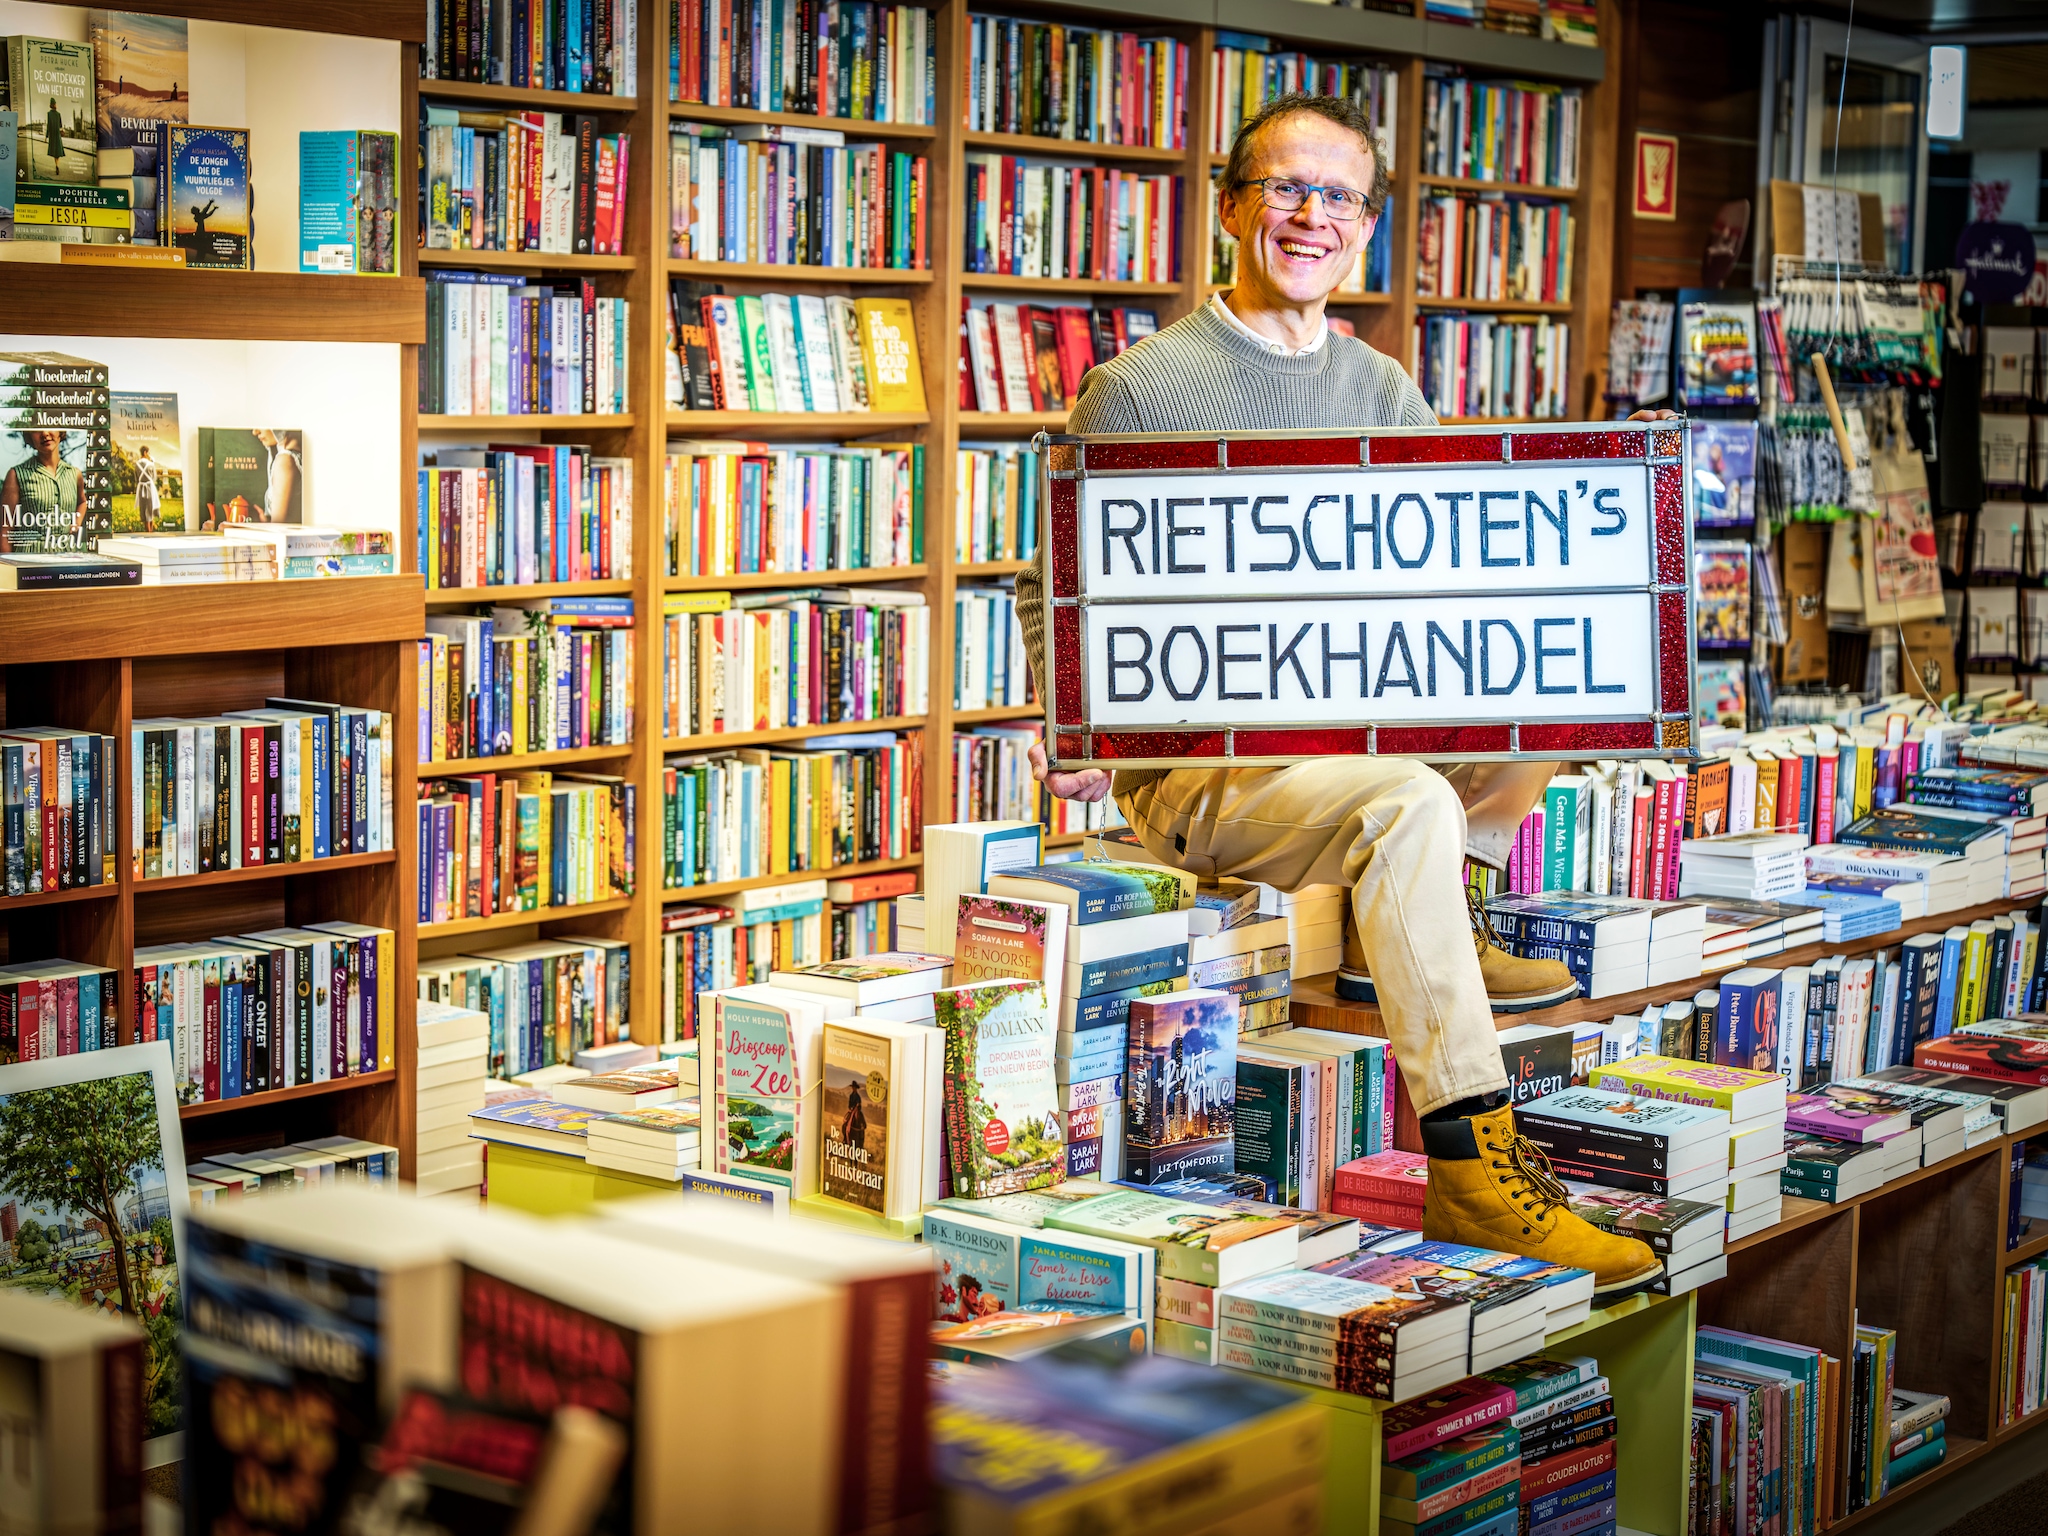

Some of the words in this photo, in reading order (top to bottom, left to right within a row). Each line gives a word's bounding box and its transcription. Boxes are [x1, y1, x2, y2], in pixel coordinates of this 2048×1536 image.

[34, 70, 43, 80] DE
[45, 71, 86, 86] ONTDEKKER
[36, 83, 50, 94] VAN
[52, 84, 62, 96] HET
[64, 86, 84, 98] LEVEN
[190, 156, 200, 164] DE
[201, 157, 228, 166] JONGEN
[198, 166, 209, 175] DIE
[212, 167, 220, 176] DE
[184, 176, 234, 186] VUURVLIEGJES
[60, 188, 98, 197] DOCHTER
[196, 186, 223, 196] VOLGDE
[50, 208, 87, 224] JESCA
[544, 186, 557, 233] Nexus
[560, 198, 571, 236] Nexus
[1965, 251, 2028, 276] Hallmark
[869, 311, 883, 325] JE
[871, 325, 900, 341] KIND
[874, 339, 886, 355] IS
[888, 340, 909, 355] EEN
[875, 355, 908, 370] GOUD
[34, 368, 92, 383] Moederheil
[877, 369, 907, 384] MIJN
[36, 390, 93, 405] Moederheil
[37, 412, 94, 427] Moederheil
[120, 408, 132, 418] De
[136, 409, 163, 420] kraam
[126, 420, 157, 431] kliniek
[2, 504, 81, 528] Moeder
[1101, 479, 1627, 576] RIETSCHOTEN's
[44, 526, 83, 549] heil
[1106, 616, 1626, 702] BOEKHANDEL
[250, 738, 259, 784] ONTWAKEN
[269, 740, 278, 779] OPSTAND
[1701, 768, 1729, 788] ROOKGAT
[28, 773, 38, 836] Vlindermeisje
[1685, 774, 1697, 823] ROOKGAT
[1556, 795, 1567, 827] Geert
[1556, 829, 1567, 853] Mak
[1846, 865, 1900, 878] ORGANISCH
[1086, 899, 1105, 907] SARAH
[1110, 904, 1120, 912] EEN
[1121, 902, 1133, 911] VER
[1134, 899, 1156, 909] EILAND
[1124, 893, 1137, 902] ROEP
[1138, 892, 1152, 900] VAN
[1537, 920, 1562, 941] LETTER
[1565, 924, 1572, 942] M
[972, 933, 1001, 945] SORAYA
[1004, 939, 1024, 948] LANE
[964, 945, 978, 959] DE
[981, 949, 1032, 969] NOORSE
[1211, 962, 1228, 971] KAREN
[1229, 959, 1248, 968] SWAN
[1089, 971, 1106, 980] SARAH
[1090, 978, 1103, 986] LARK
[1211, 968, 1253, 982] STORMGLOED
[1245, 987, 1278, 1000] VERLANGEN
[1084, 1006, 1102, 1014] SARAH
[1786, 991, 1795, 1020] Virginia
[256, 1000, 267, 1048] ONTZET
[727, 1013, 750, 1023] HOLLY
[752, 1017, 784, 1028] HEPBURN
[994, 1010, 1028, 1020] Corina
[980, 1017, 1045, 1040] BOMANN
[1700, 1013, 1712, 1050] laatste
[1785, 1022, 1793, 1052] Mendoza
[727, 1030, 787, 1063] Bioscoop
[828, 1047, 862, 1062] NICHOLAS
[864, 1056, 886, 1067] EVANS
[989, 1051, 1024, 1064] DROMEN
[1026, 1048, 1042, 1058] VAN
[983, 1066, 998, 1077] EEN
[1000, 1063, 1025, 1075] NIEUW
[1027, 1060, 1050, 1072] BEGIN
[1518, 1056, 1534, 1085] Je
[1924, 1058, 1938, 1067] ROB
[1939, 1060, 1951, 1069] VAN
[1952, 1061, 1970, 1071] ESSEN
[1972, 1066, 1992, 1075] KWADE
[1994, 1068, 2013, 1078] DAGEN
[732, 1068, 751, 1078] aan
[751, 1064, 792, 1096] Zee
[1509, 1074, 1563, 1102] leven
[945, 1080, 954, 1101] EEN
[1074, 1081, 1102, 1098] SARAH
[1077, 1095, 1098, 1108] LARK
[949, 1103, 959, 1139] NIEUW
[956, 1090, 966, 1139] DROMEN
[1072, 1110, 1099, 1127] SARAH
[830, 1126, 839, 1139] De
[1076, 1123, 1096, 1138] LARK
[826, 1138, 871, 1164] paarden-
[953, 1141, 962, 1173] BEGIN
[960, 1139, 969, 1163] VAN
[1072, 1143, 1099, 1161] SARAH
[1578, 1148, 1594, 1157] ARJEN
[1595, 1150, 1605, 1158] VAN
[1606, 1152, 1626, 1161] VEELEN
[1075, 1156, 1095, 1172] LARK
[1158, 1163, 1172, 1174] LIZ
[1172, 1154, 1225, 1172] TOMFORDE
[1554, 1165, 1569, 1175] LYNN
[1570, 1168, 1594, 1178] BERGER
[1786, 1167, 1804, 1176] Parijs
[830, 1157, 883, 1190] fluisteraar
[692, 1181, 721, 1196] SUSAN
[723, 1187, 762, 1204] MUSKEE
[1344, 1176, 1353, 1189] DE
[1356, 1178, 1383, 1193] REGELS
[1385, 1183, 1399, 1195] VAN
[1401, 1185, 1424, 1200] PEARL
[1784, 1185, 1802, 1195] Parijs
[931, 1224, 952, 1239] B.K.
[955, 1230, 1008, 1252] BORISON
[1034, 1245, 1057, 1258] JANA
[1059, 1251, 1110, 1268] SCHIKORRA
[1028, 1258, 1068, 1277] Zomer
[1230, 1305, 1259, 1318] HARMEL
[1262, 1308, 1284, 1321] VOOR
[1285, 1313, 1311, 1327] ALTIJD
[1312, 1319, 1322, 1329] BIJ
[1323, 1321, 1336, 1332] MIJ
[1227, 1329, 1256, 1342] HARMEL
[1259, 1333, 1282, 1345] VOOR
[1282, 1338, 1308, 1352] ALTIJD
[1309, 1344, 1320, 1354] BIJ
[1321, 1347, 1333, 1357] MIJ
[1536, 1372, 1578, 1400] Kerstverhalen
[1437, 1421, 1464, 1437] SUMMER
[1465, 1416, 1472, 1426] IN
[1474, 1412, 1486, 1423] THE
[1487, 1402, 1502, 1418] CITY
[1575, 1426, 1604, 1444] MISTLETOE
[1546, 1464, 1579, 1484] GOUDEN
[1580, 1454, 1604, 1472] LOTUS
[1533, 1497, 1558, 1513] CHARLOTTE
